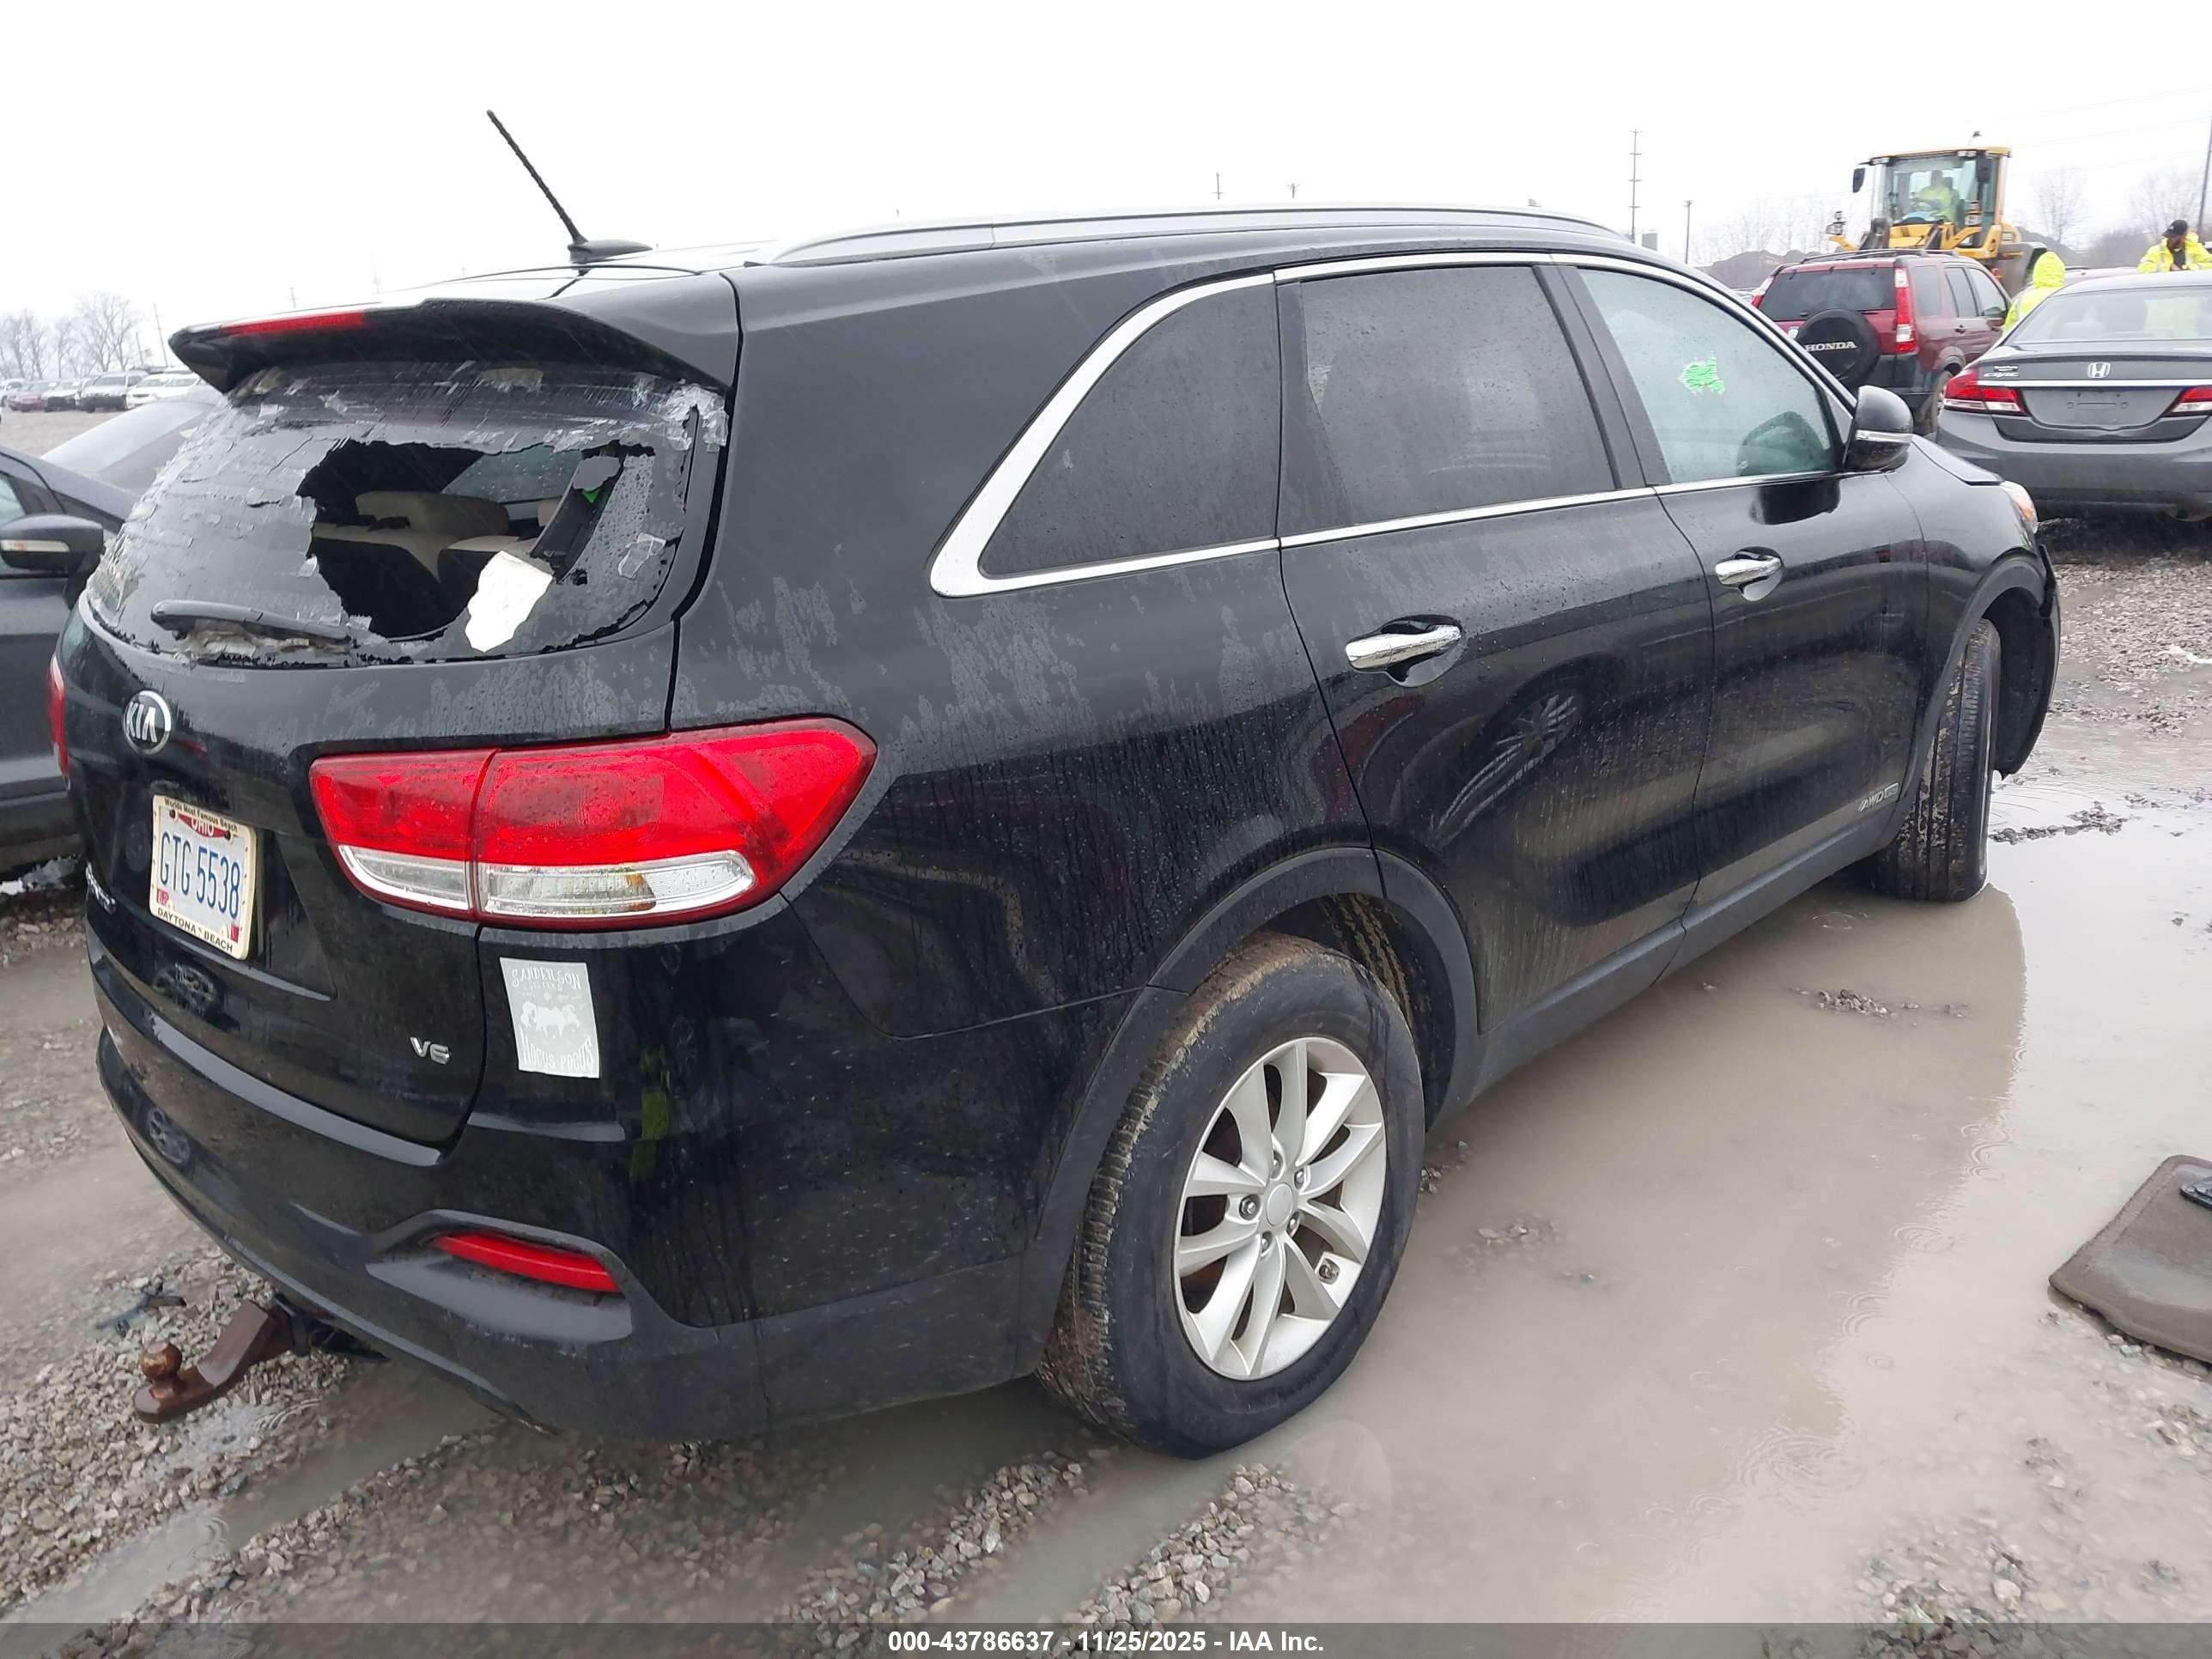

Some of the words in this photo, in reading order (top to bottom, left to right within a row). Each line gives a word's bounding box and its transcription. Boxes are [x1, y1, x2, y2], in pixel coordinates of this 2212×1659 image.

[1804, 341, 1857, 352] HONDA
[126, 701, 158, 743] KIA
[183, 803, 197, 816] Most
[197, 809, 220, 825] Famous
[220, 817, 239, 833] Beach
[160, 830, 191, 896] GTG
[196, 845, 240, 920] 5538
[157, 907, 197, 933] DAYTONA
[204, 931, 234, 953] BEACH
[511, 966, 582, 991] SANDERSON
[410, 1036, 450, 1065] V6
[518, 1023, 556, 1069] HOCUS
[560, 1035, 595, 1073] POCUS
